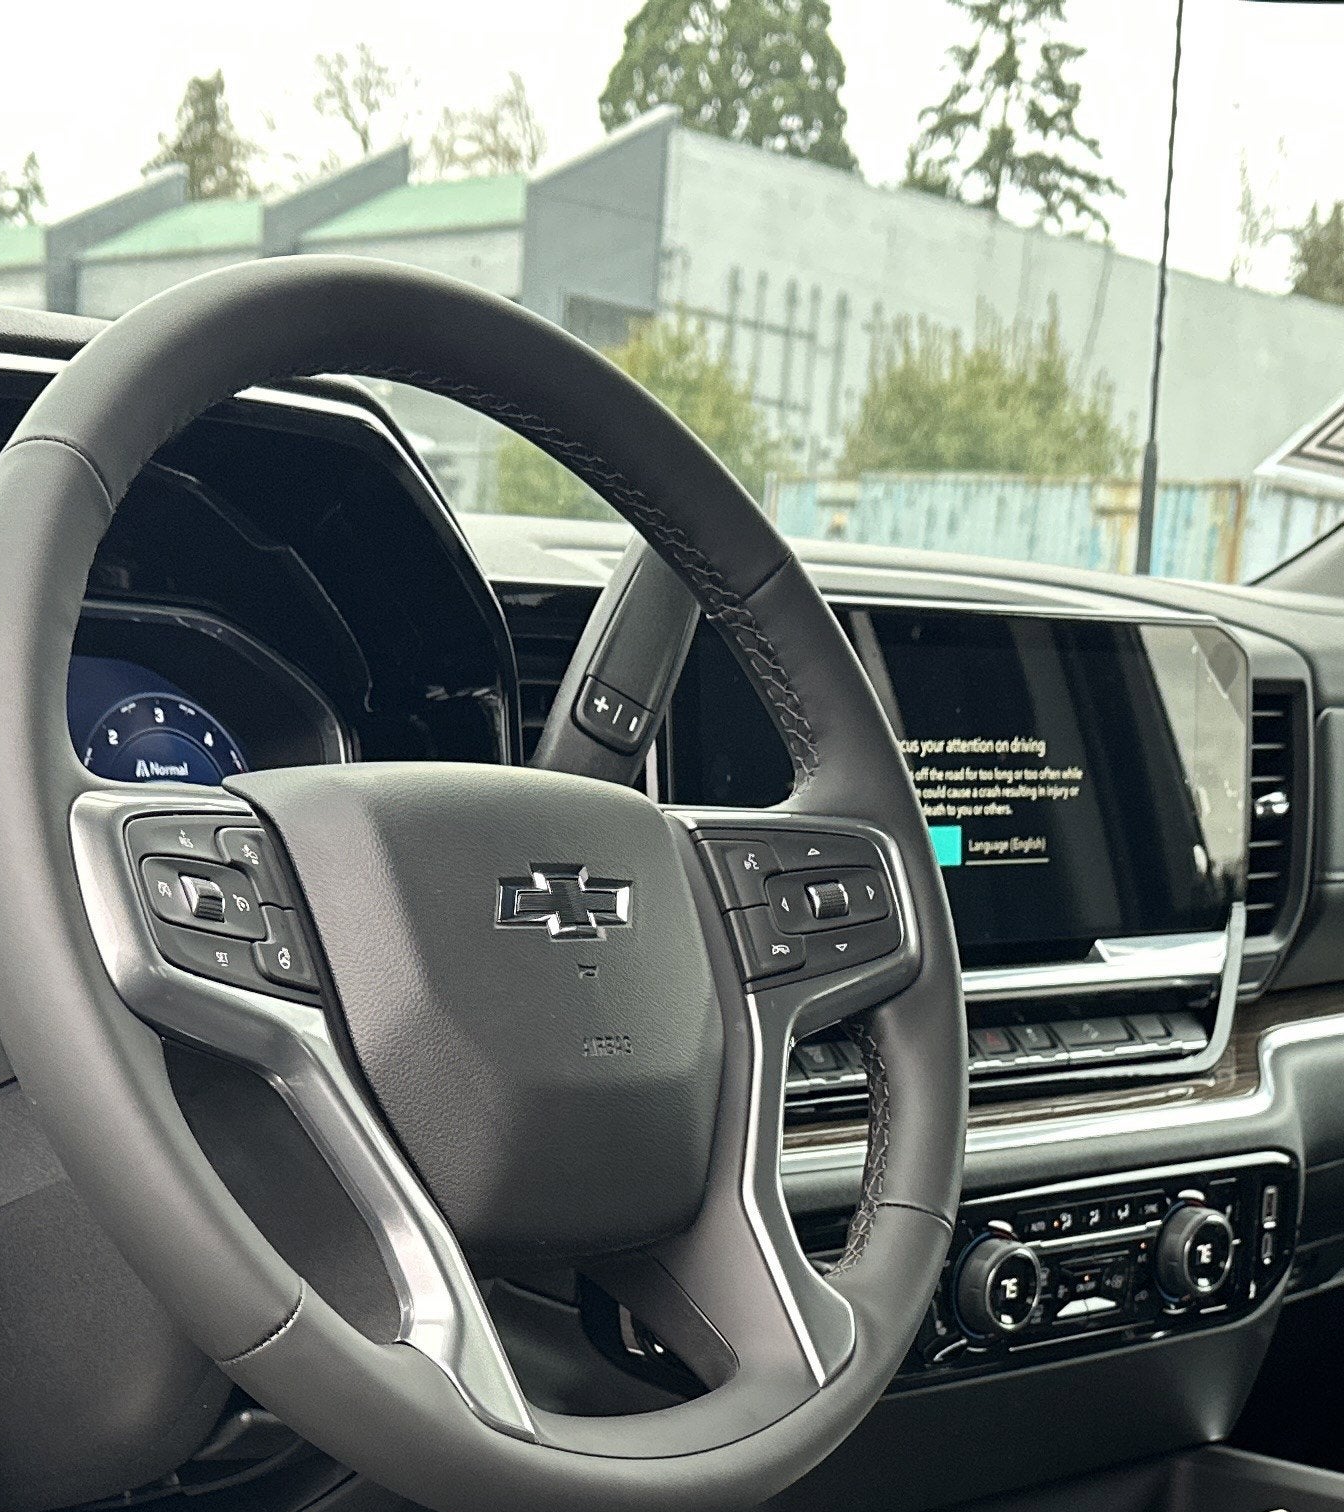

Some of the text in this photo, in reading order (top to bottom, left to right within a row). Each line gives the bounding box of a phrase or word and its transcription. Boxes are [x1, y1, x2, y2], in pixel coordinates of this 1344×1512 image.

[153, 708, 165, 723] 3
[107, 729, 119, 745] 2
[203, 732, 214, 747] 4
[898, 735, 1046, 757] cus your attention on driving
[150, 761, 189, 777] Normal
[929, 767, 944, 781] the
[945, 767, 965, 781] road
[965, 766, 978, 781] for
[994, 766, 1014, 783] long
[922, 784, 946, 798] could
[946, 787, 971, 798] cause
[978, 784, 1001, 798] crash
[1001, 783, 1037, 801] resulting
[956, 805, 973, 819] you
[968, 835, 1047, 854] Language (English)
[215, 951, 229, 963] SET
